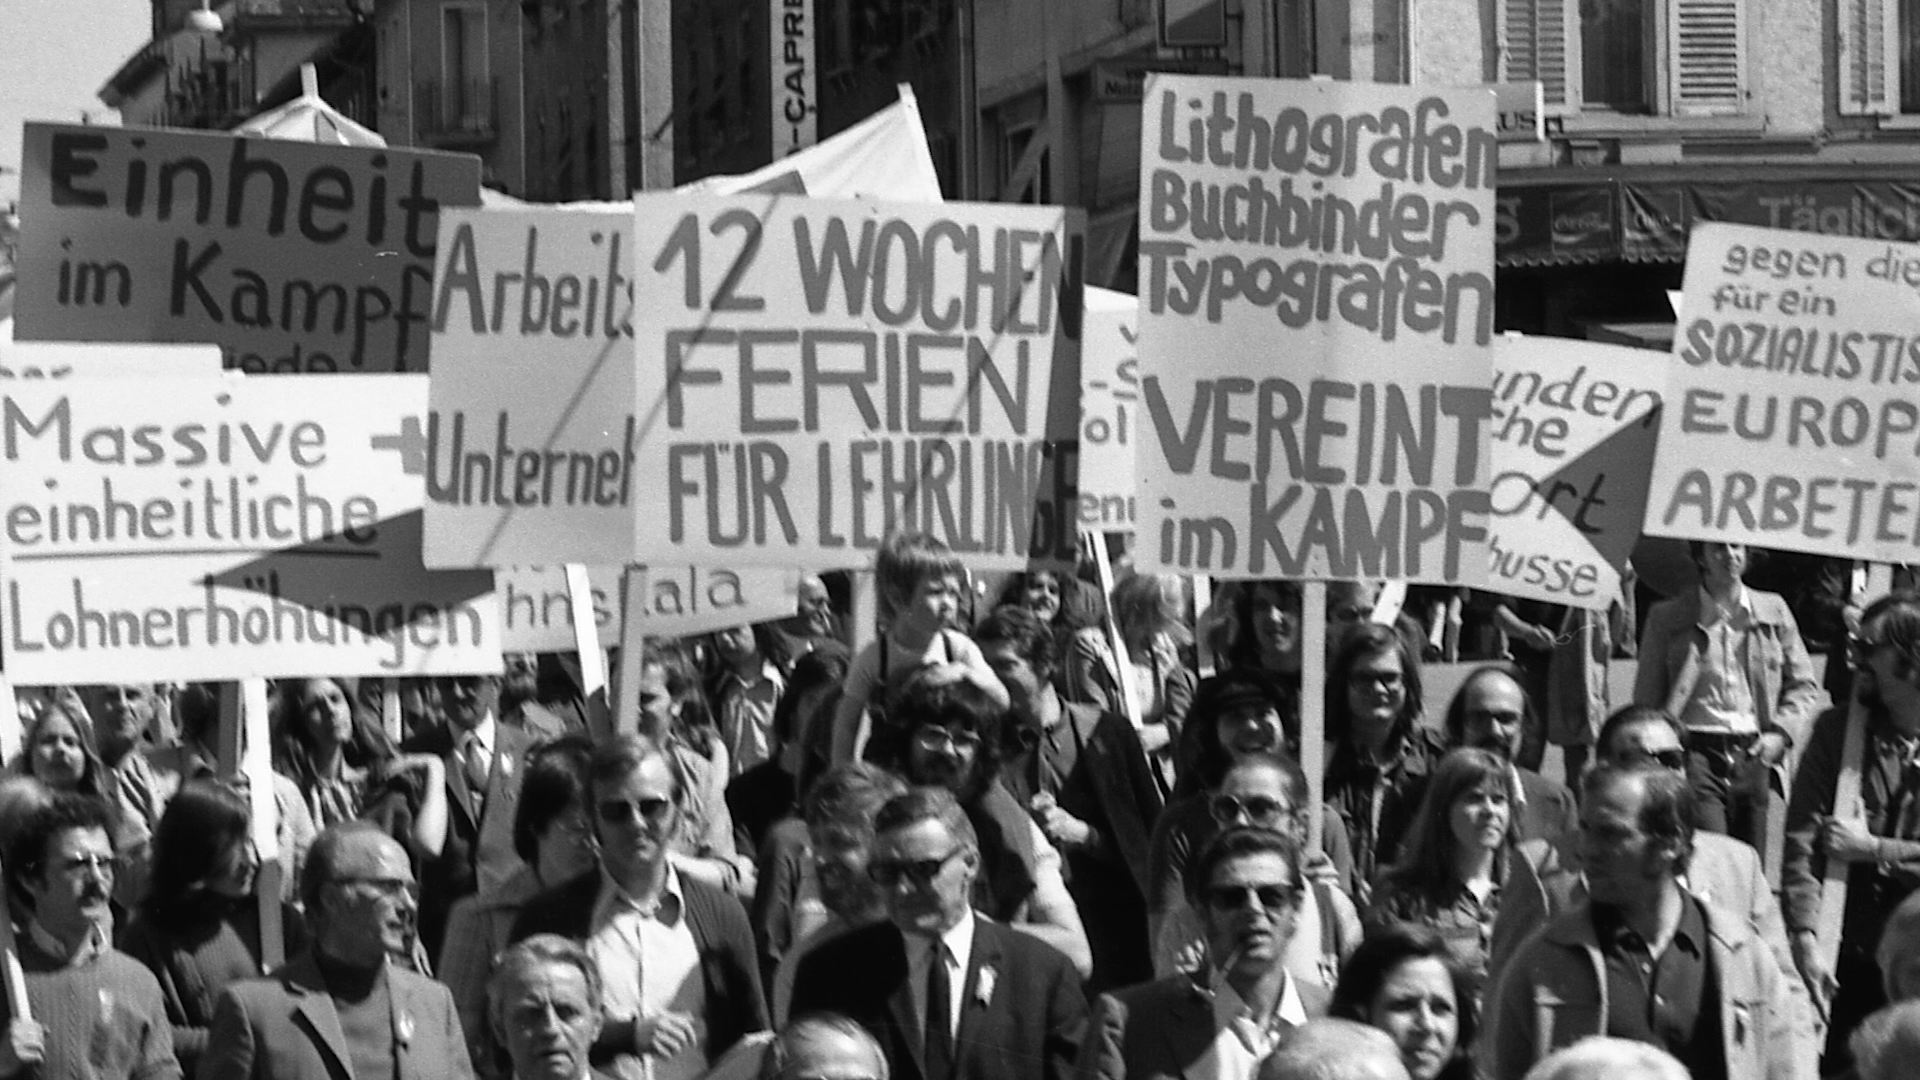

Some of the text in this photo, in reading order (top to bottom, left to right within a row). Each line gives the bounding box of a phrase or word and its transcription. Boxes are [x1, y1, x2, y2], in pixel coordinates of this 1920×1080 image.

[1158, 90, 1498, 189] Lithografen
[50, 133, 438, 258] Einheit
[1150, 168, 1481, 263] Buchbinder
[57, 236, 434, 372] im Kampf
[652, 209, 1085, 340] 12 WOCHEN
[1140, 240, 1494, 348] Typografen
[1712, 284, 1837, 317] für ein
[1723, 243, 1920, 288] gegen die
[3, 392, 328, 468] Massive
[665, 328, 1032, 436] FERIEN
[1141, 374, 1493, 487] VEREINT
[1682, 388, 1920, 459] EUROP
[6, 475, 379, 546] einheitliche
[668, 439, 1080, 563] FÜR LEHRLINGE
[1159, 480, 1492, 582] im KAMPF
[1490, 471, 1607, 534] Ort
[1664, 469, 1920, 547] ARBETE
[7, 570, 484, 669] Lohnerhöhungen
